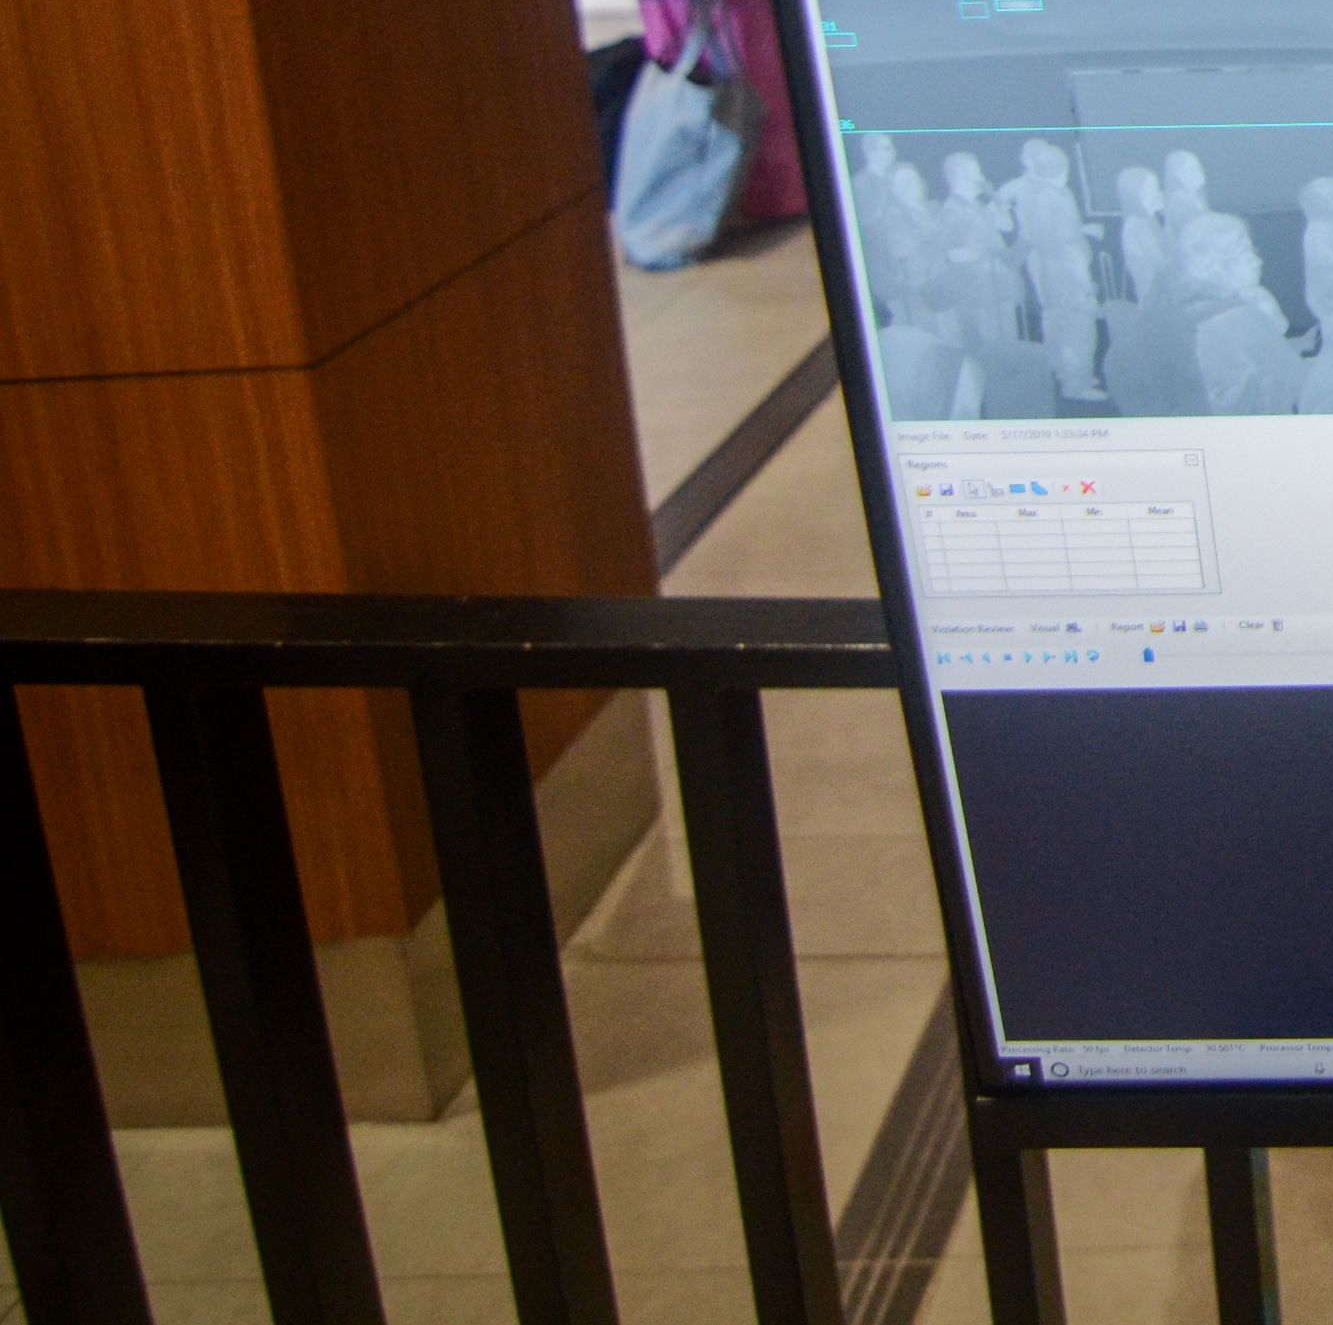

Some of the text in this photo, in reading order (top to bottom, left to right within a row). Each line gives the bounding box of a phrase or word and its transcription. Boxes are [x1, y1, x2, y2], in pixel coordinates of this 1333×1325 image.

[898, 432, 930, 444] Image
[1091, 428, 1110, 439] PM
[907, 459, 948, 472] Regions
[1018, 508, 1038, 518] Max
[1086, 507, 1104, 517] Min
[1148, 505, 1175, 516] Mean
[1030, 623, 1060, 633] Visual
[1111, 621, 1144, 633] Report
[1239, 618, 1265, 629] Clear
[1002, 1045, 1051, 1056] Processing
[1124, 1043, 1164, 1054] Detector
[1259, 1042, 1304, 1053] Processor
[1077, 1064, 1188, 1077] Type here to search
